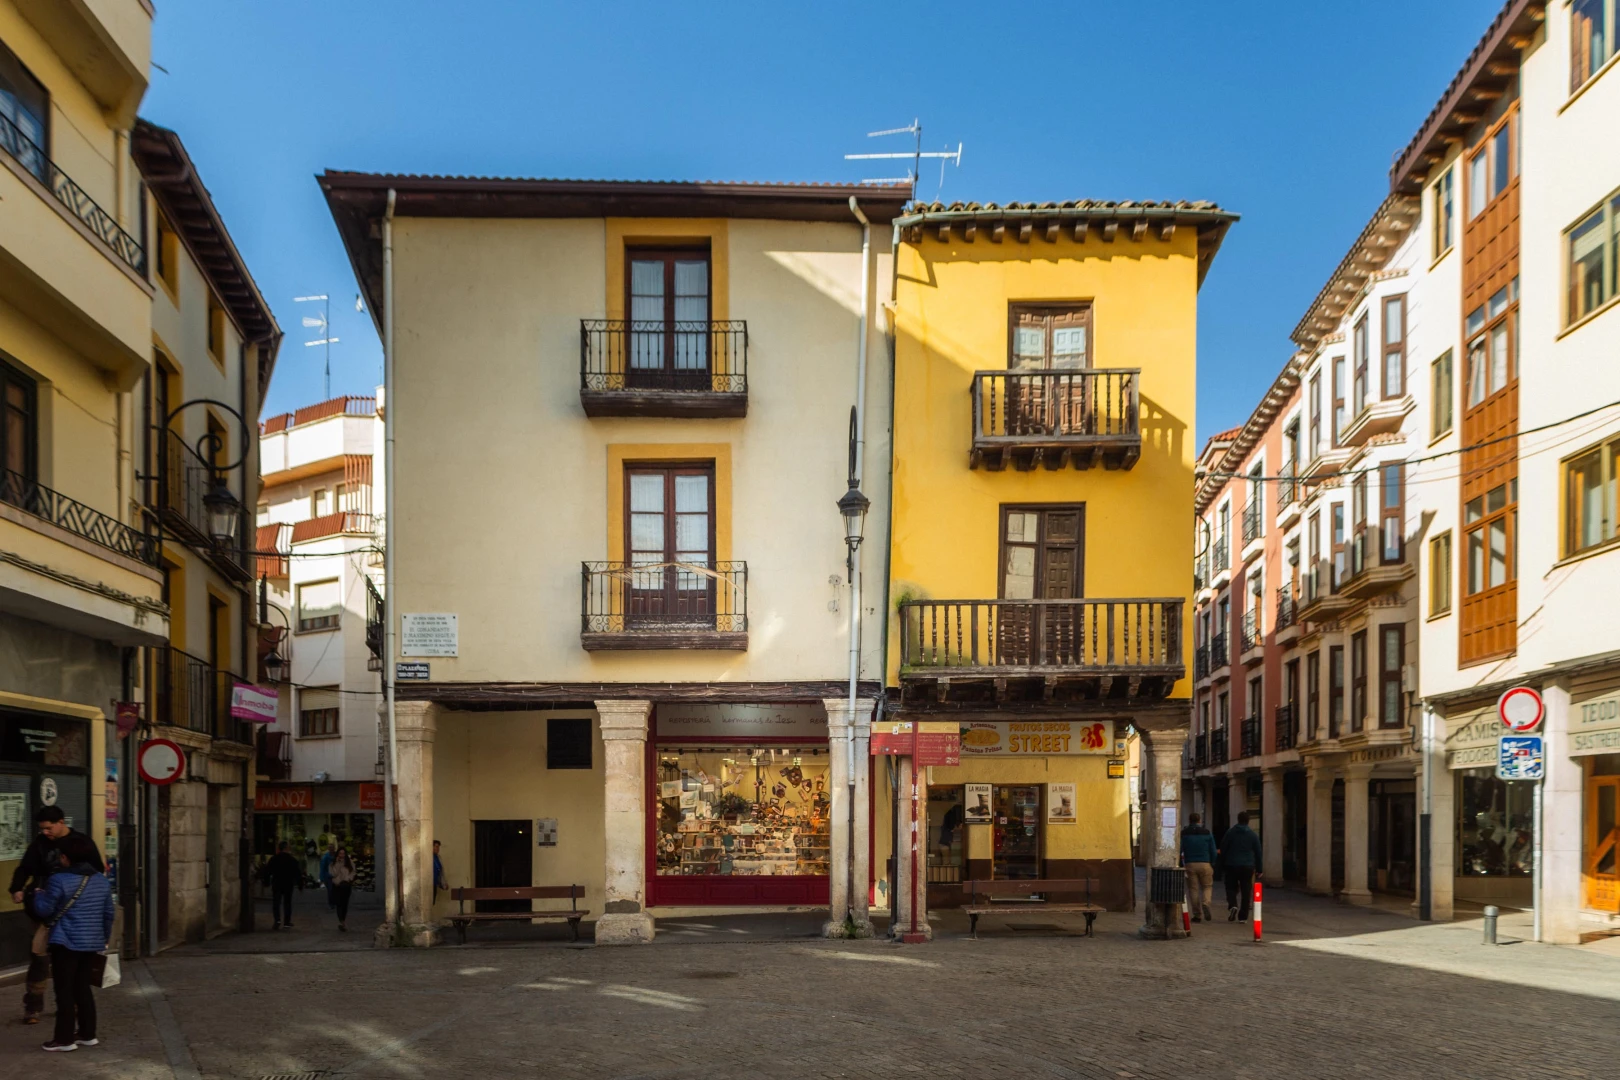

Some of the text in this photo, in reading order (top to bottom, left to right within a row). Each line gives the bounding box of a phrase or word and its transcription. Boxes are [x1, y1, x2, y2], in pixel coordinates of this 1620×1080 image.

[1008, 722, 1071, 732] FRUTOS SECOS
[1008, 734, 1072, 752] STREET
[261, 788, 307, 808] MUÑOZ
